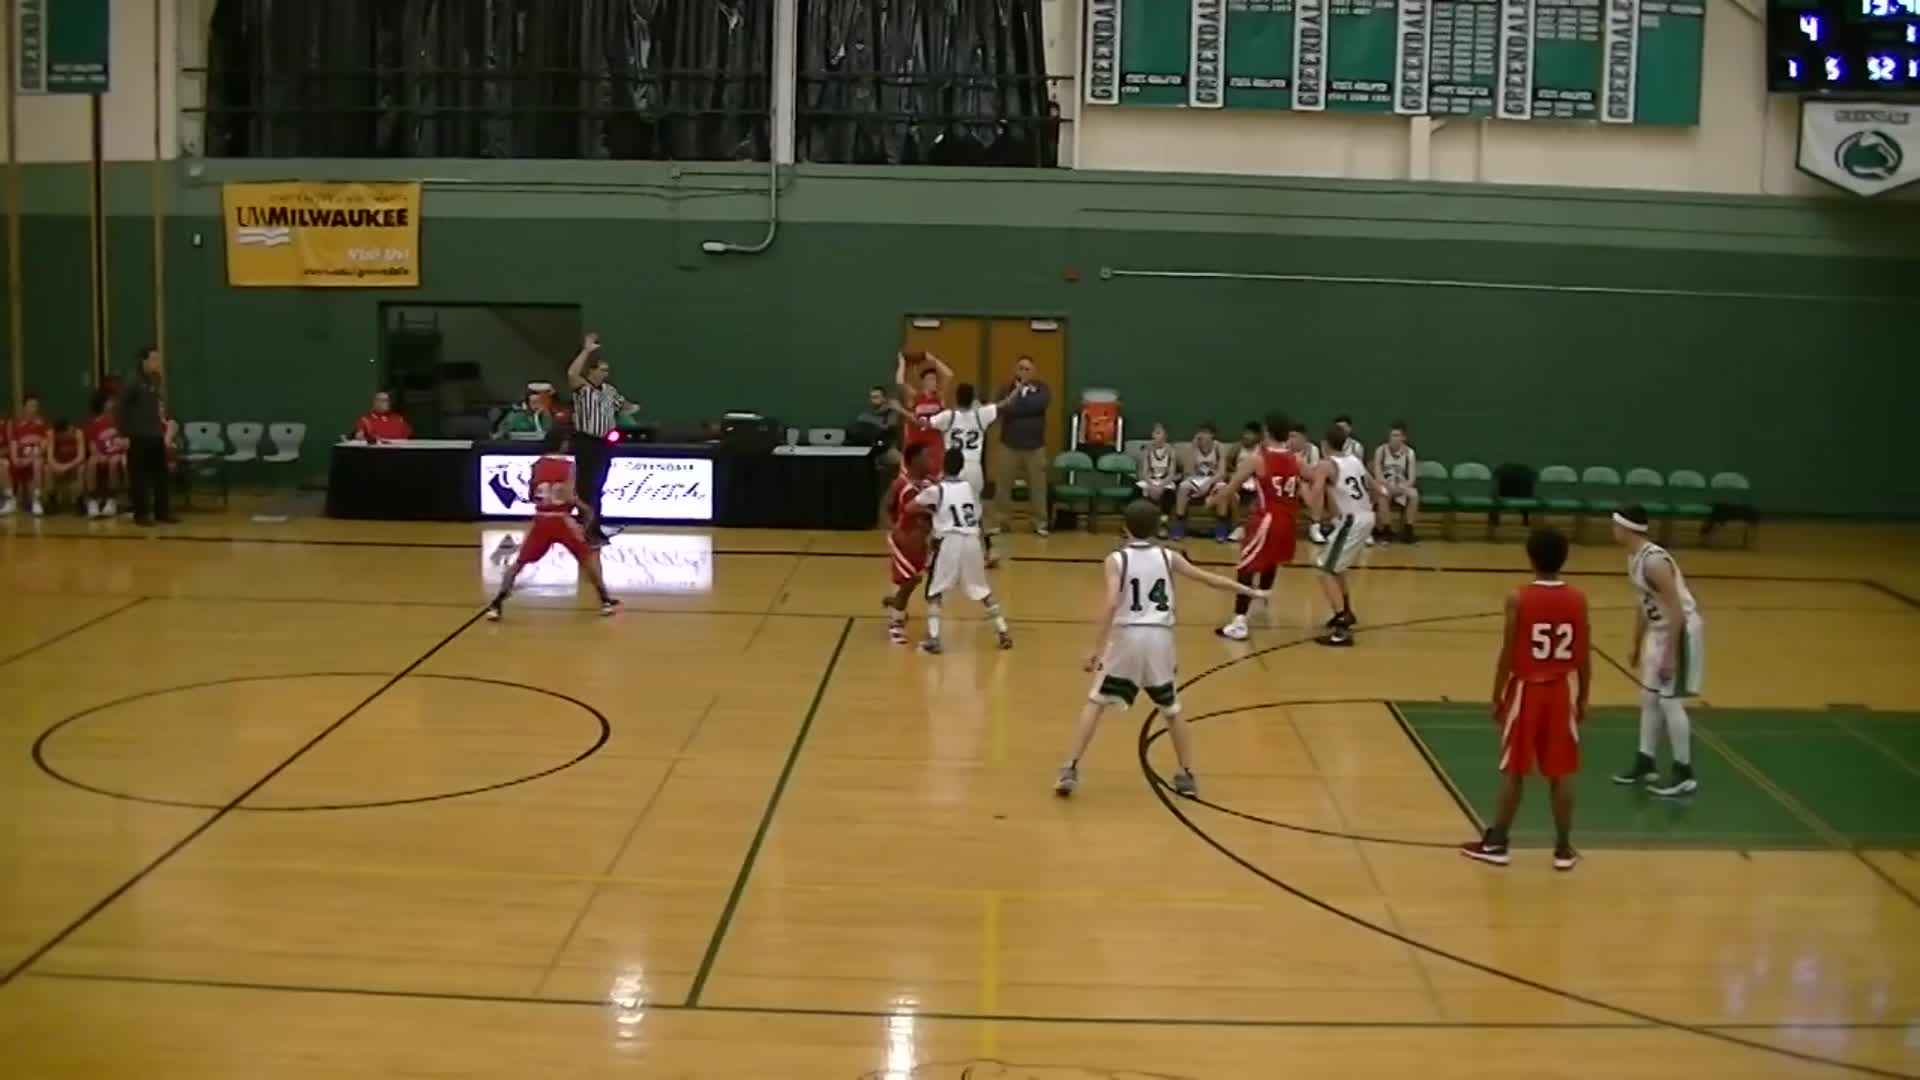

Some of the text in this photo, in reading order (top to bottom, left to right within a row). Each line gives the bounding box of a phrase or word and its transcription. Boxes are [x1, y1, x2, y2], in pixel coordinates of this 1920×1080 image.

[1799, 14, 1819, 42] 4
[1608, 0, 1633, 117] GREENDALE
[950, 430, 979, 449] 52
[1270, 475, 1297, 498] 54
[1129, 577, 1170, 612] 14
[1531, 622, 1574, 661] 52
